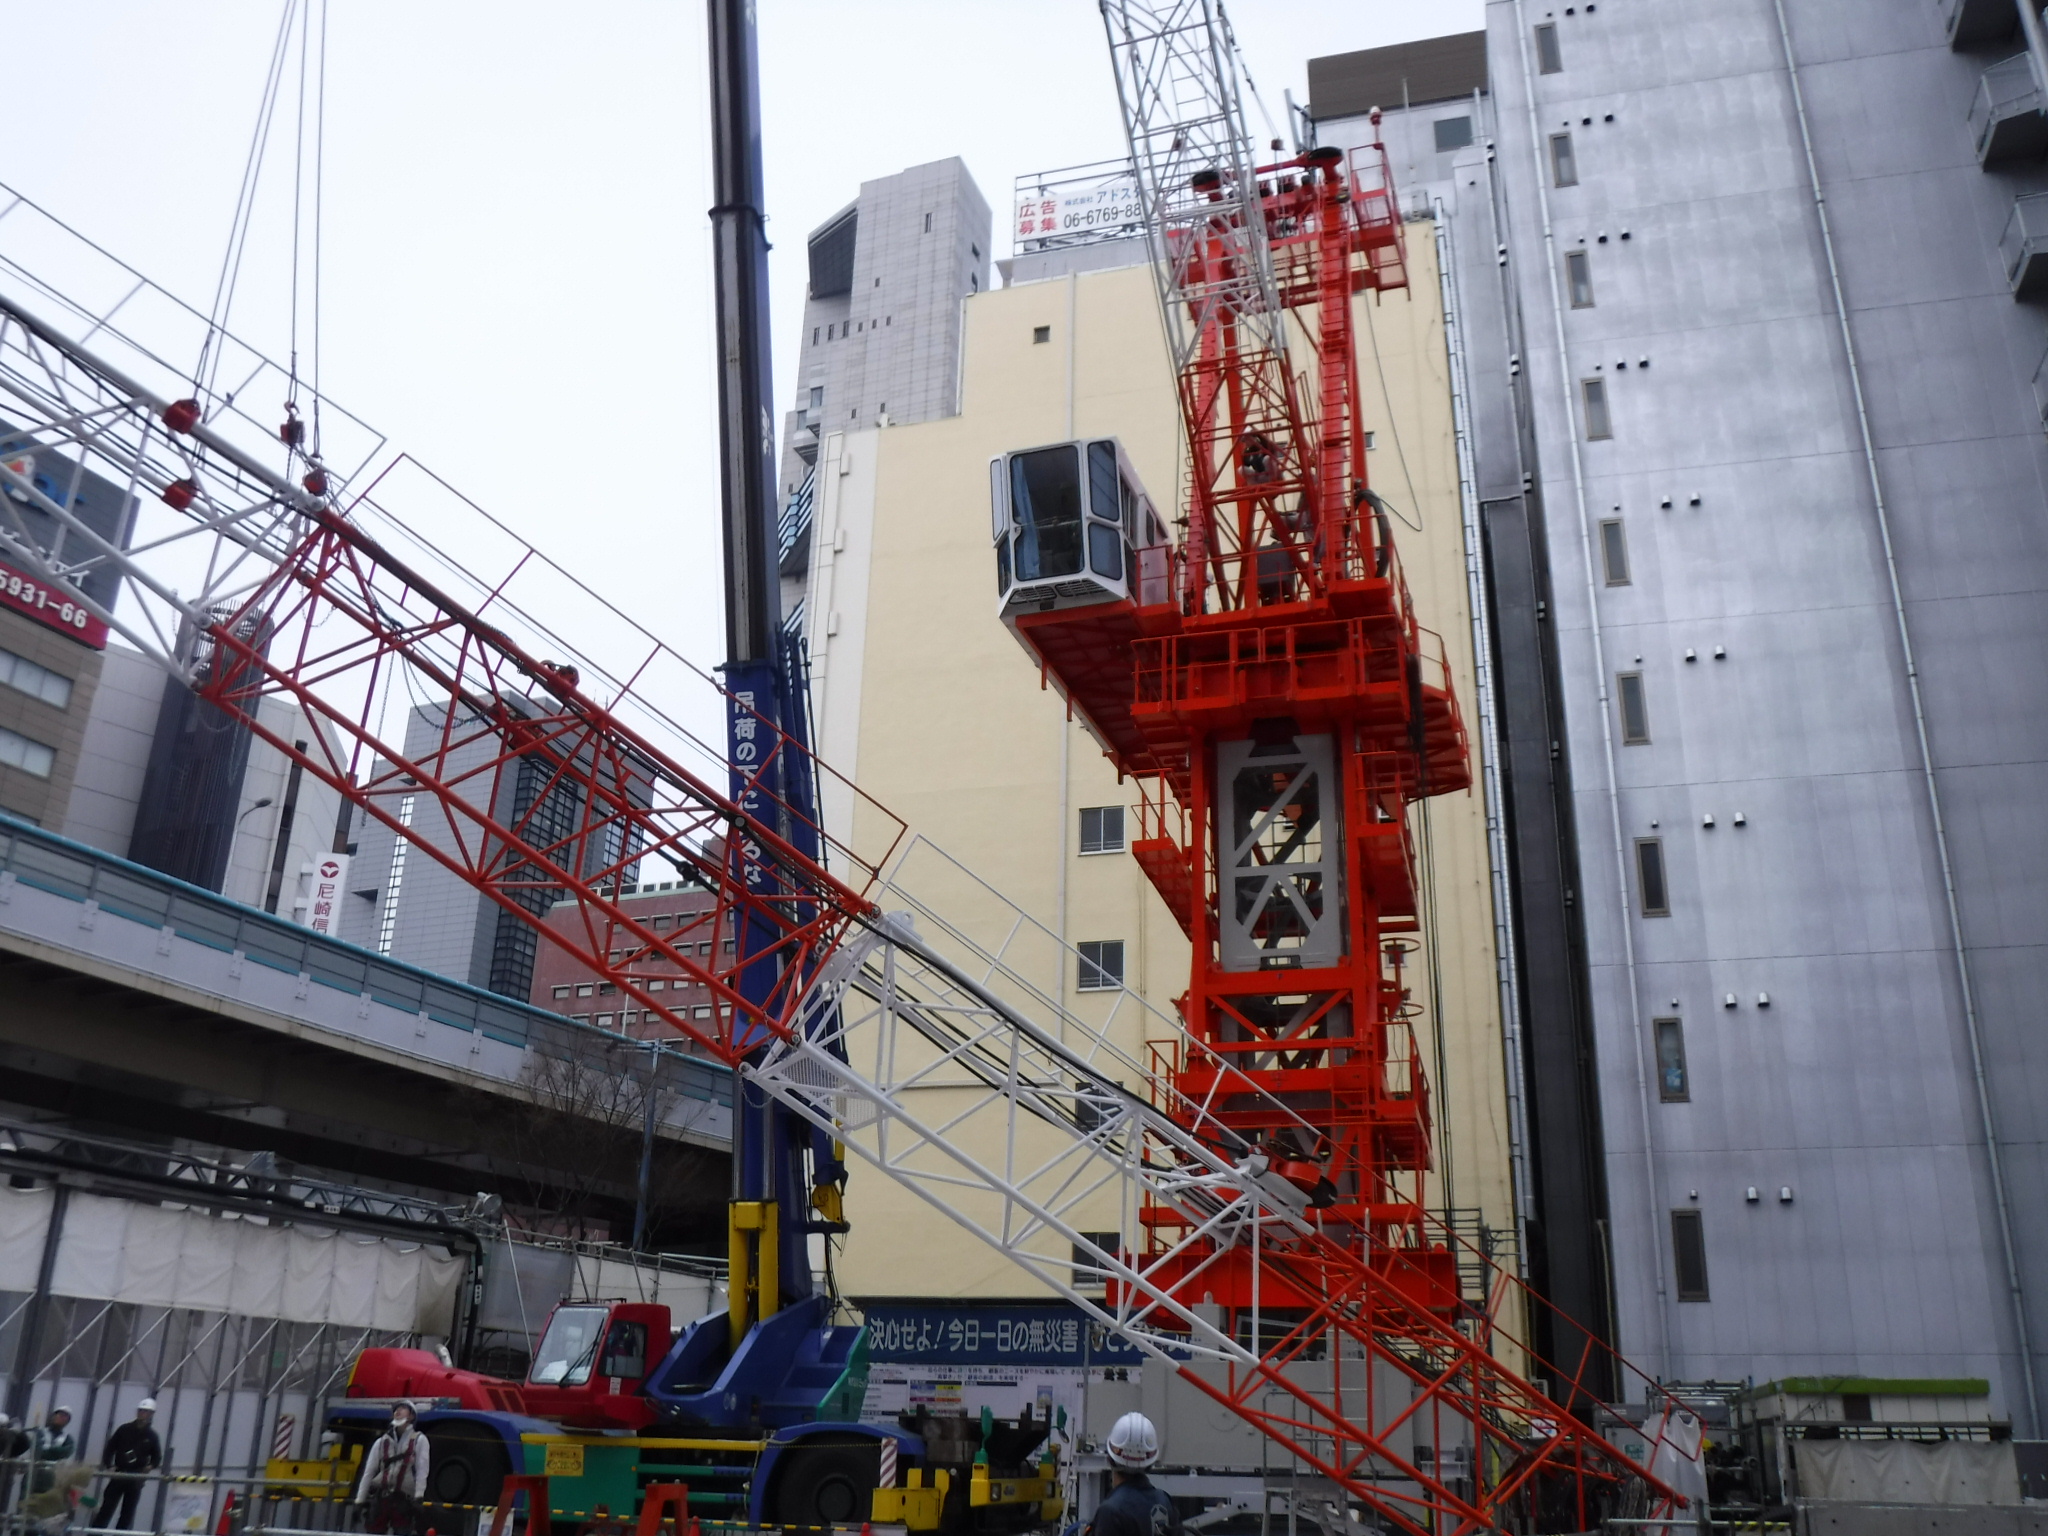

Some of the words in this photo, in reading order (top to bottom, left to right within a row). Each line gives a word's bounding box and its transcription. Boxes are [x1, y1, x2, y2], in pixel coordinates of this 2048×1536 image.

[1019, 200, 1057, 218] 広告
[1064, 202, 1142, 228] 06-6769-88
[1019, 217, 1057, 235] 募集
[734, 691, 762, 885] 吊荷の下にるな
[311, 883, 335, 934] 尼崎信
